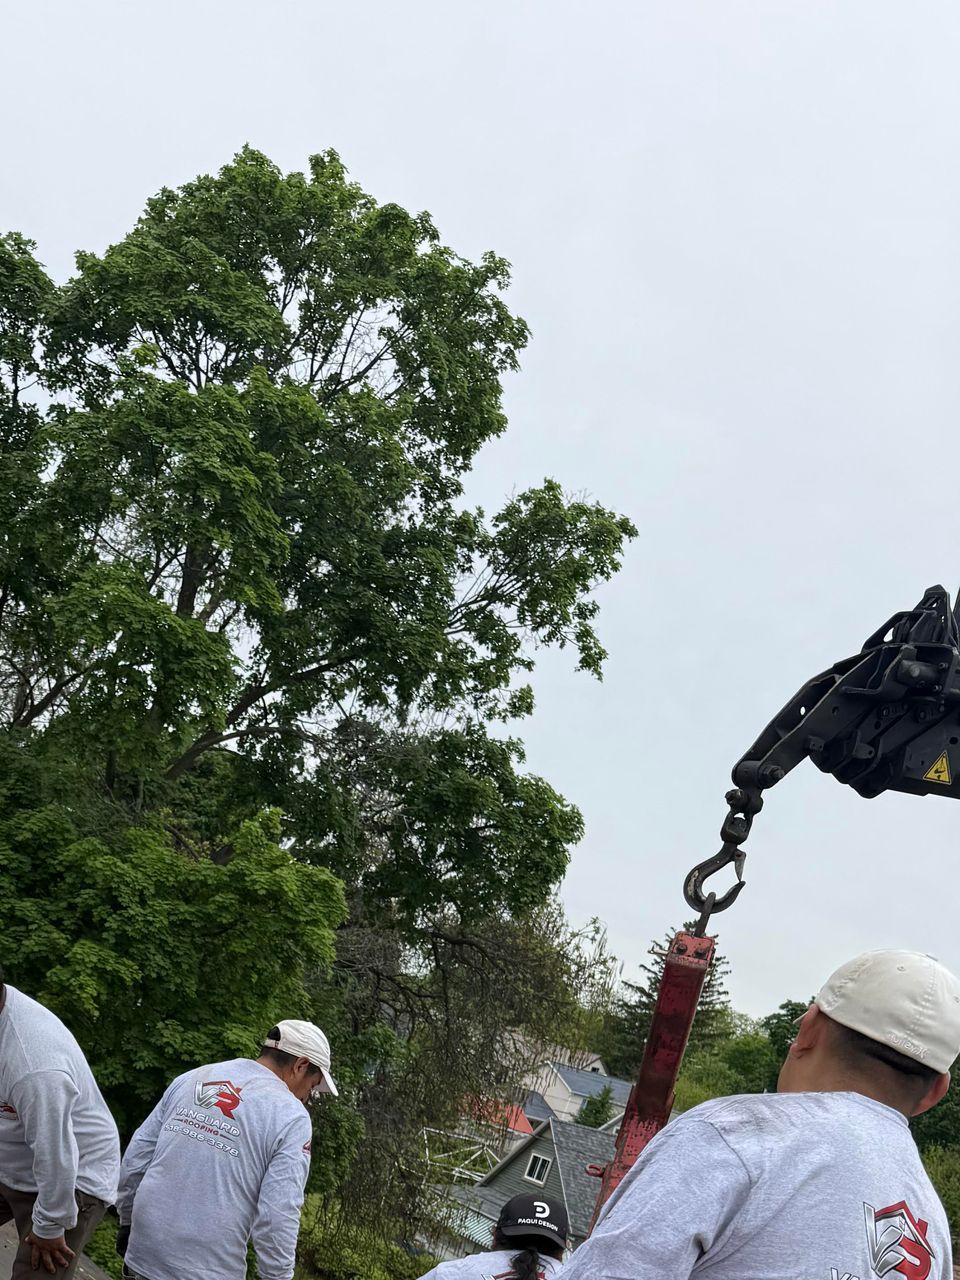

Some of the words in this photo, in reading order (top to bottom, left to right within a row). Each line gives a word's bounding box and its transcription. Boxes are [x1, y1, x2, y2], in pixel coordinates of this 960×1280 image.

[176, 1108, 240, 1137] VANGUARD
[184, 1119, 219, 1136] ROOFING
[164, 1124, 239, 1158] 518-986-3378
[538, 1220, 558, 1231] DESIGN
